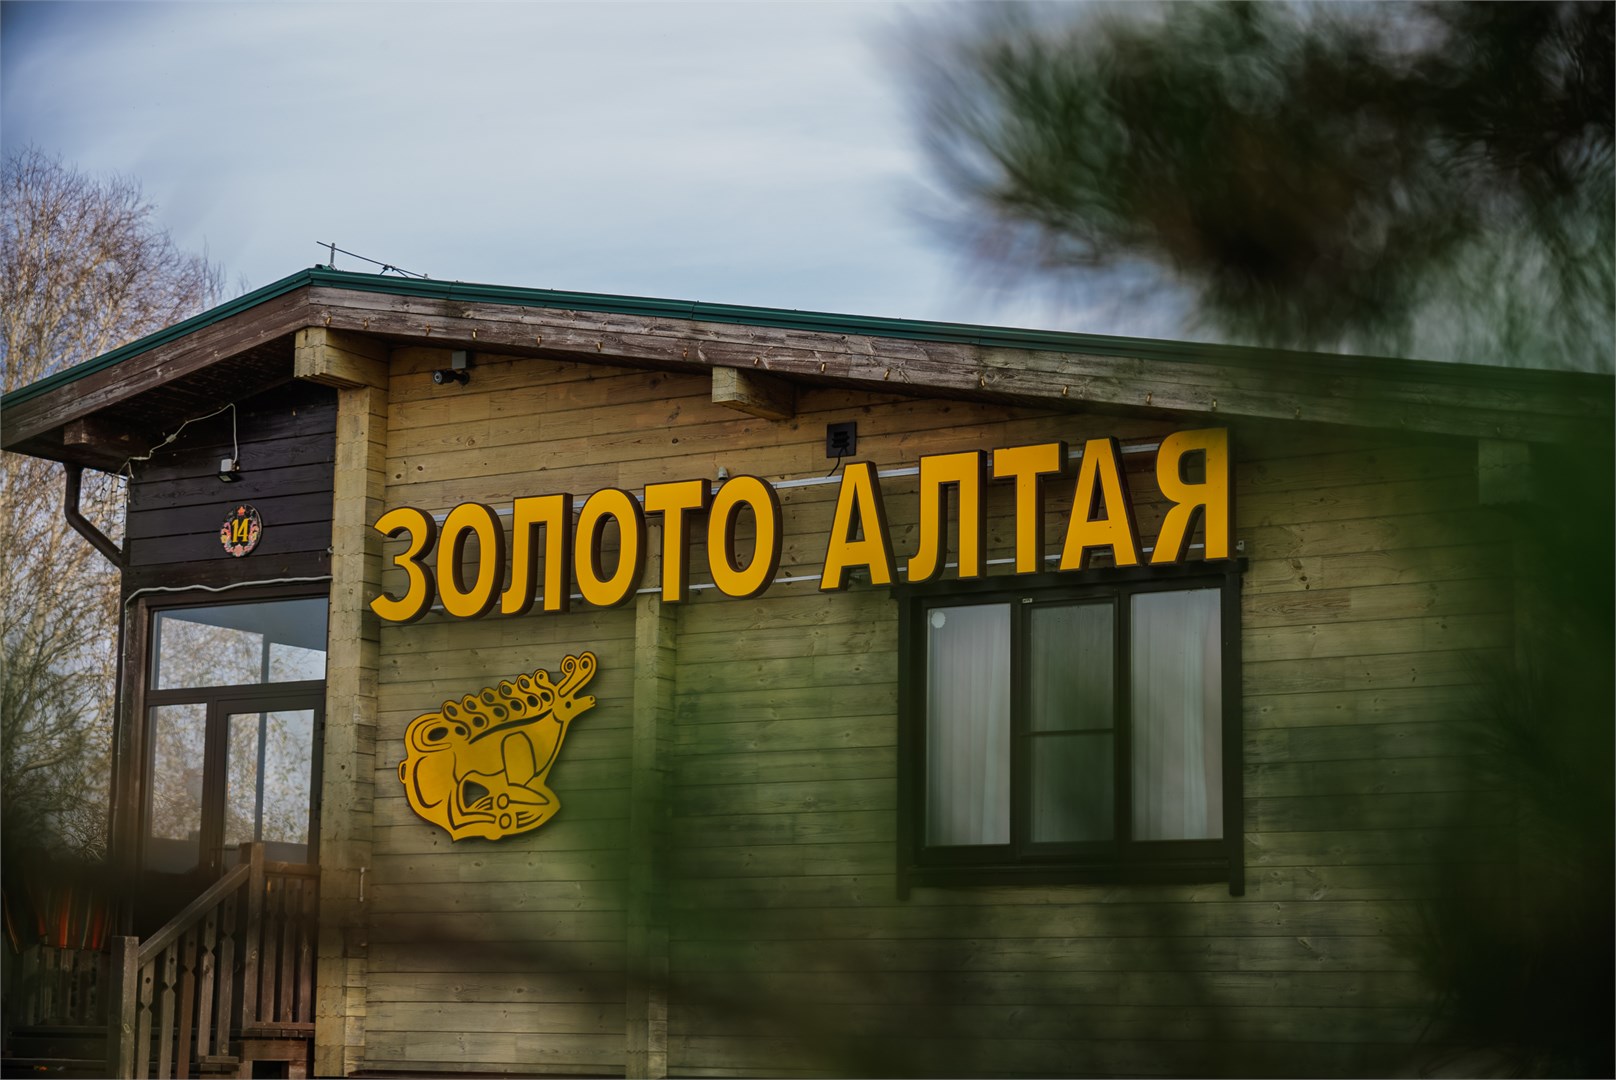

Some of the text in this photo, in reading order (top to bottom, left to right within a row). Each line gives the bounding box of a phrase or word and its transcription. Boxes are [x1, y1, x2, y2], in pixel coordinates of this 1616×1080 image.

[231, 517, 250, 543] 14
[369, 427, 1233, 624] ЗОЛОТО АЛТАЯ
